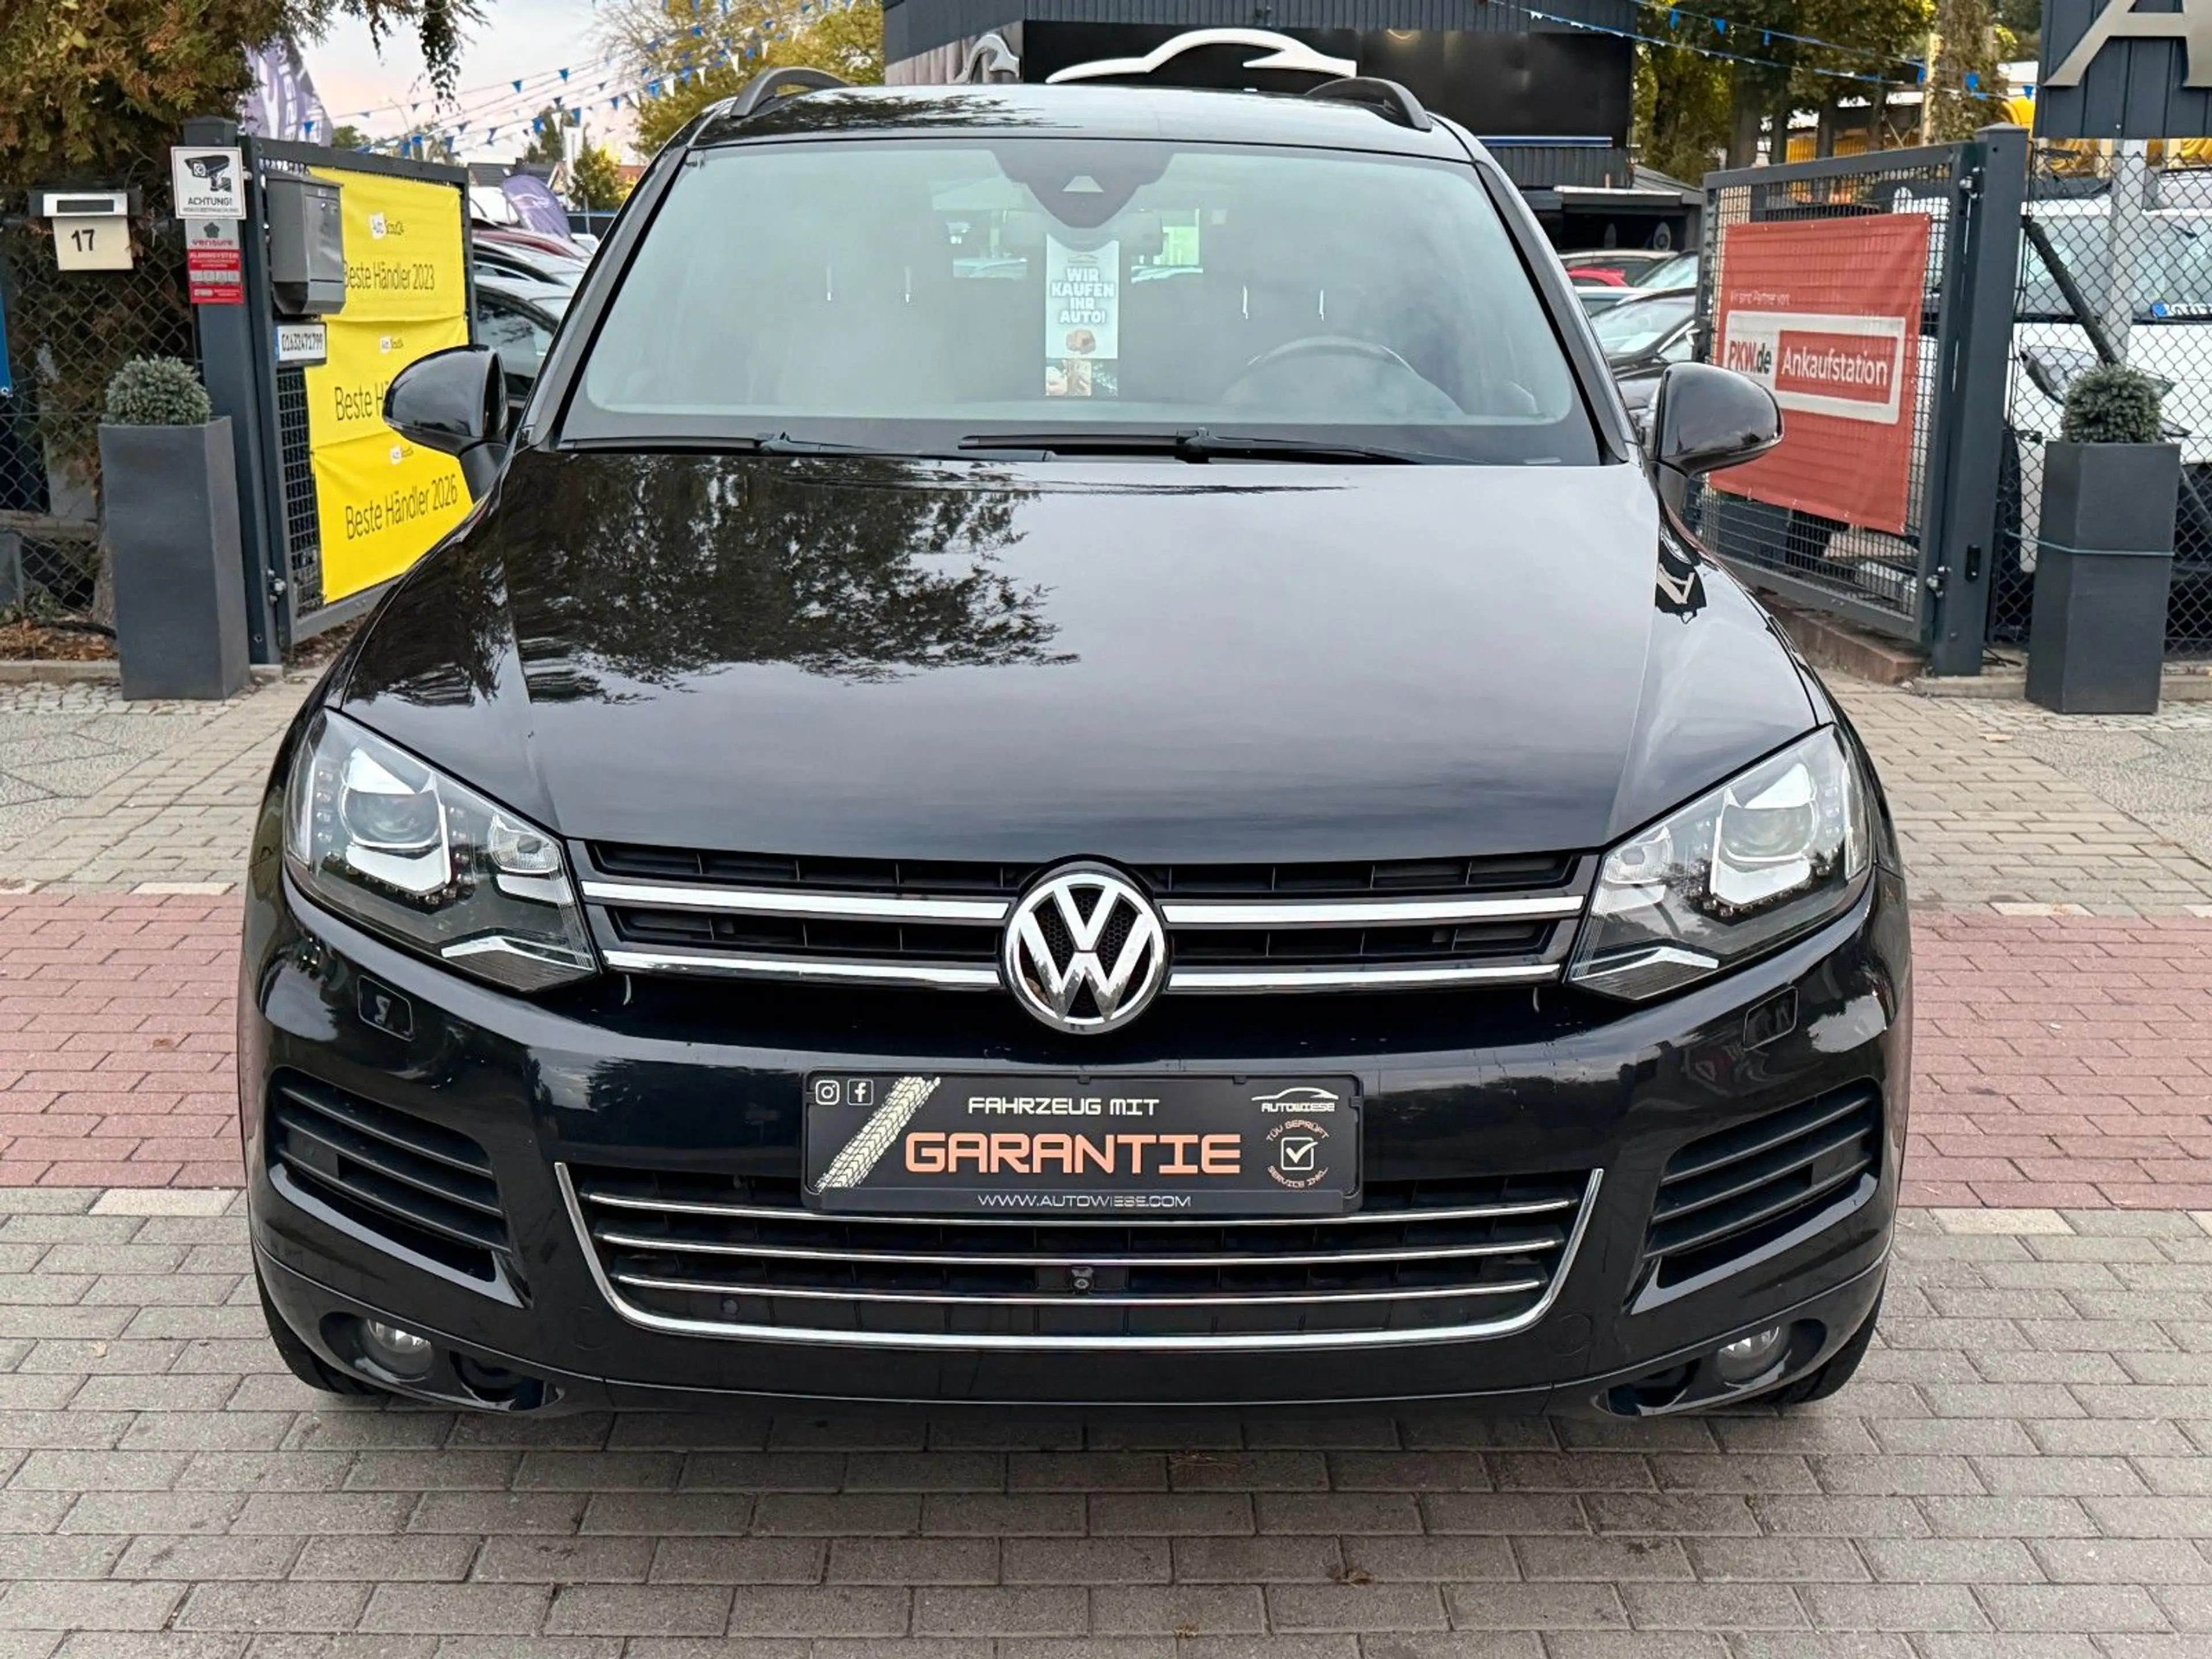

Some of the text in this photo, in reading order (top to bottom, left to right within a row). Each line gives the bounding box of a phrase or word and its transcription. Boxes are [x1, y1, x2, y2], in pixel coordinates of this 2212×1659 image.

[188, 196, 233, 206] ACHTUNG!
[71, 229, 94, 252] 17
[374, 261, 410, 290] Händler
[412, 263, 435, 290] 2023
[1067, 267, 1099, 282] WIR
[1051, 282, 1115, 297] KAUFEN
[1070, 297, 1095, 310] IHR
[1059, 310, 1106, 324] AUTO!
[1728, 340, 1888, 387] PKW.de Ankaufstation
[334, 384, 373, 421] Beste
[346, 499, 382, 540] Beste
[385, 485, 429, 528] Händler
[969, 1097, 1160, 1116] FAHRZEUG MIT
[1262, 1103, 1335, 1113] AUTOWIESE
[905, 1132, 1241, 1174] GARANTIE
[978, 1195, 1192, 1207] WWW.AUTOWIESE.COM
